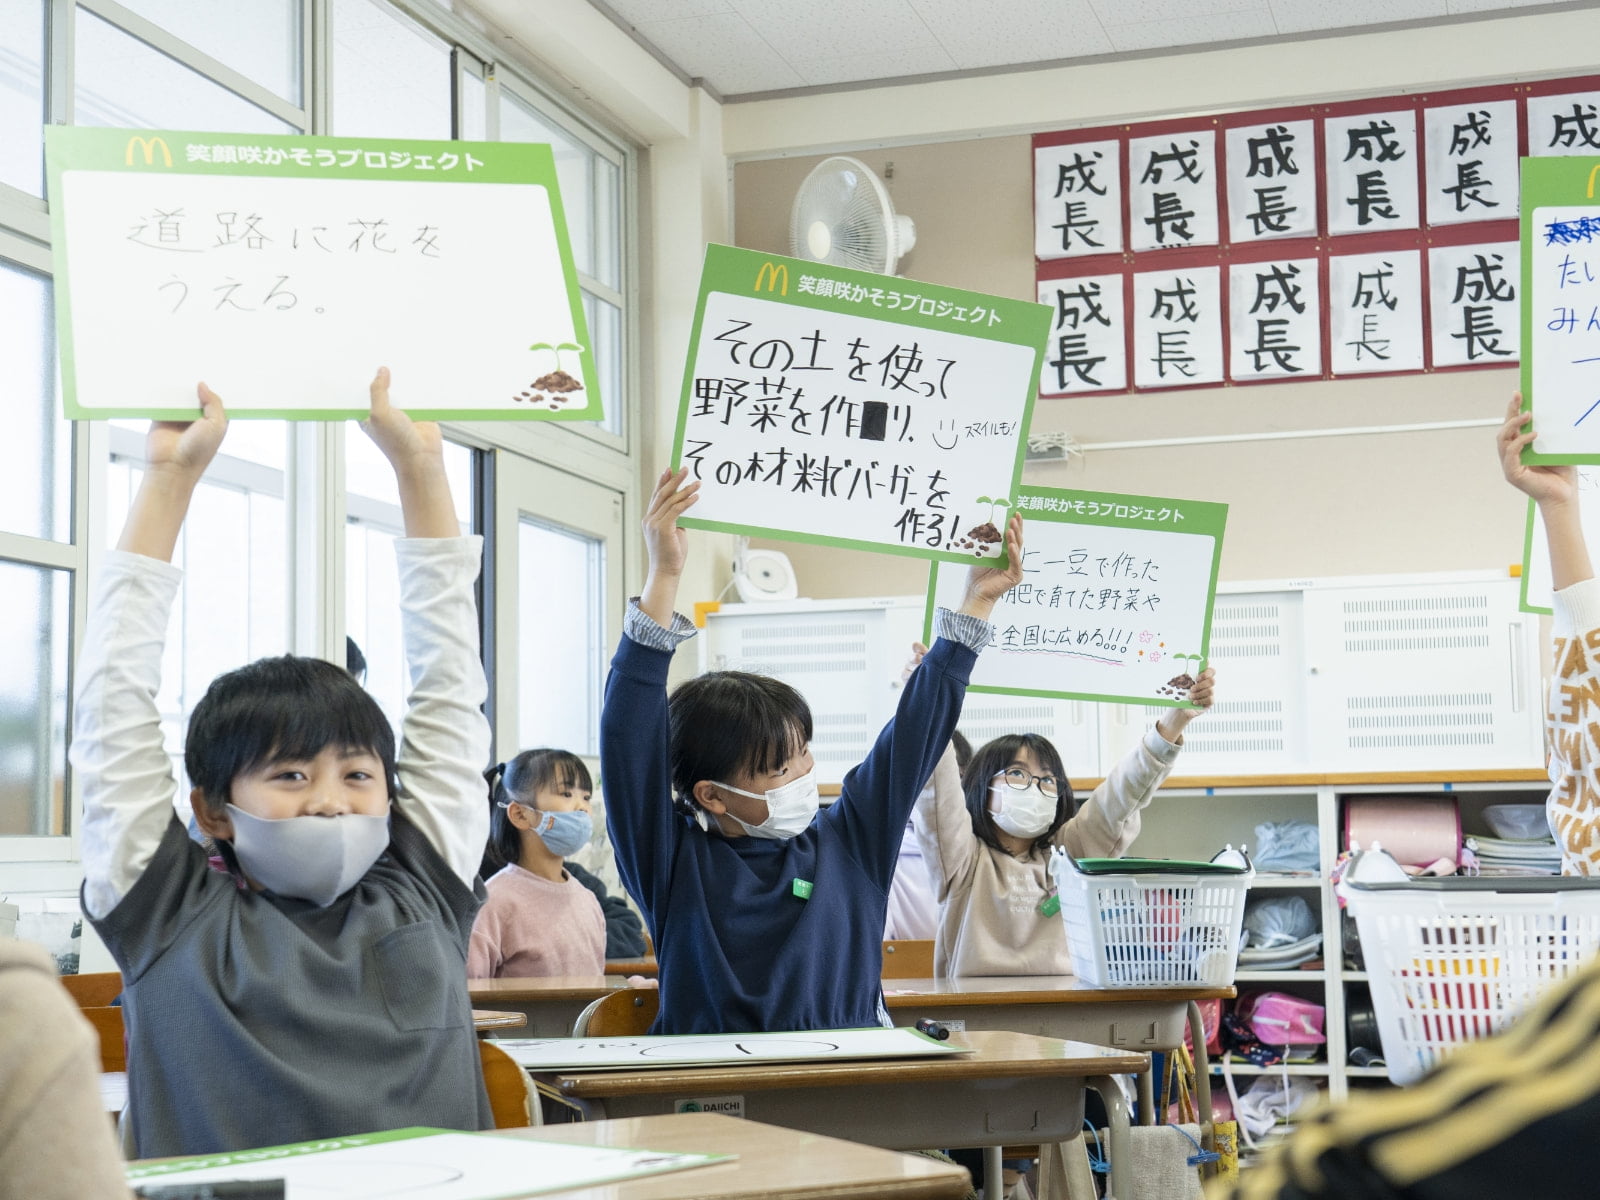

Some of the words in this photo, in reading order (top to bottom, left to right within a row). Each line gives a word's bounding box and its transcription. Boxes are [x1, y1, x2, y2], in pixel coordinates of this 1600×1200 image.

[186, 142, 485, 173] 笑顔咲かそうプロジェクト
[1051, 151, 1108, 251] 成長
[1140, 140, 1206, 244] 成長
[1246, 125, 1300, 236] 成長
[1343, 120, 1406, 226] 成長
[1442, 110, 1500, 211] 成長
[126, 207, 441, 258] 道路に花を
[158, 274, 328, 314] うえる。
[797, 274, 1003, 328] 笑顔咲かそうプロジェクト
[1050, 281, 1112, 390] 成長
[1150, 277, 1200, 379] 成長
[1244, 263, 1306, 373] 成長
[1346, 261, 1398, 361] 成長
[1450, 254, 1516, 361] 成長
[713, 318, 957, 399] その土を使って
[684, 439, 951, 509] その材料でバーガーを
[1016, 494, 1185, 524] 笑顔咲かそうプロジェクト
[1001, 583, 1161, 612] 肥で育てた野菜や
